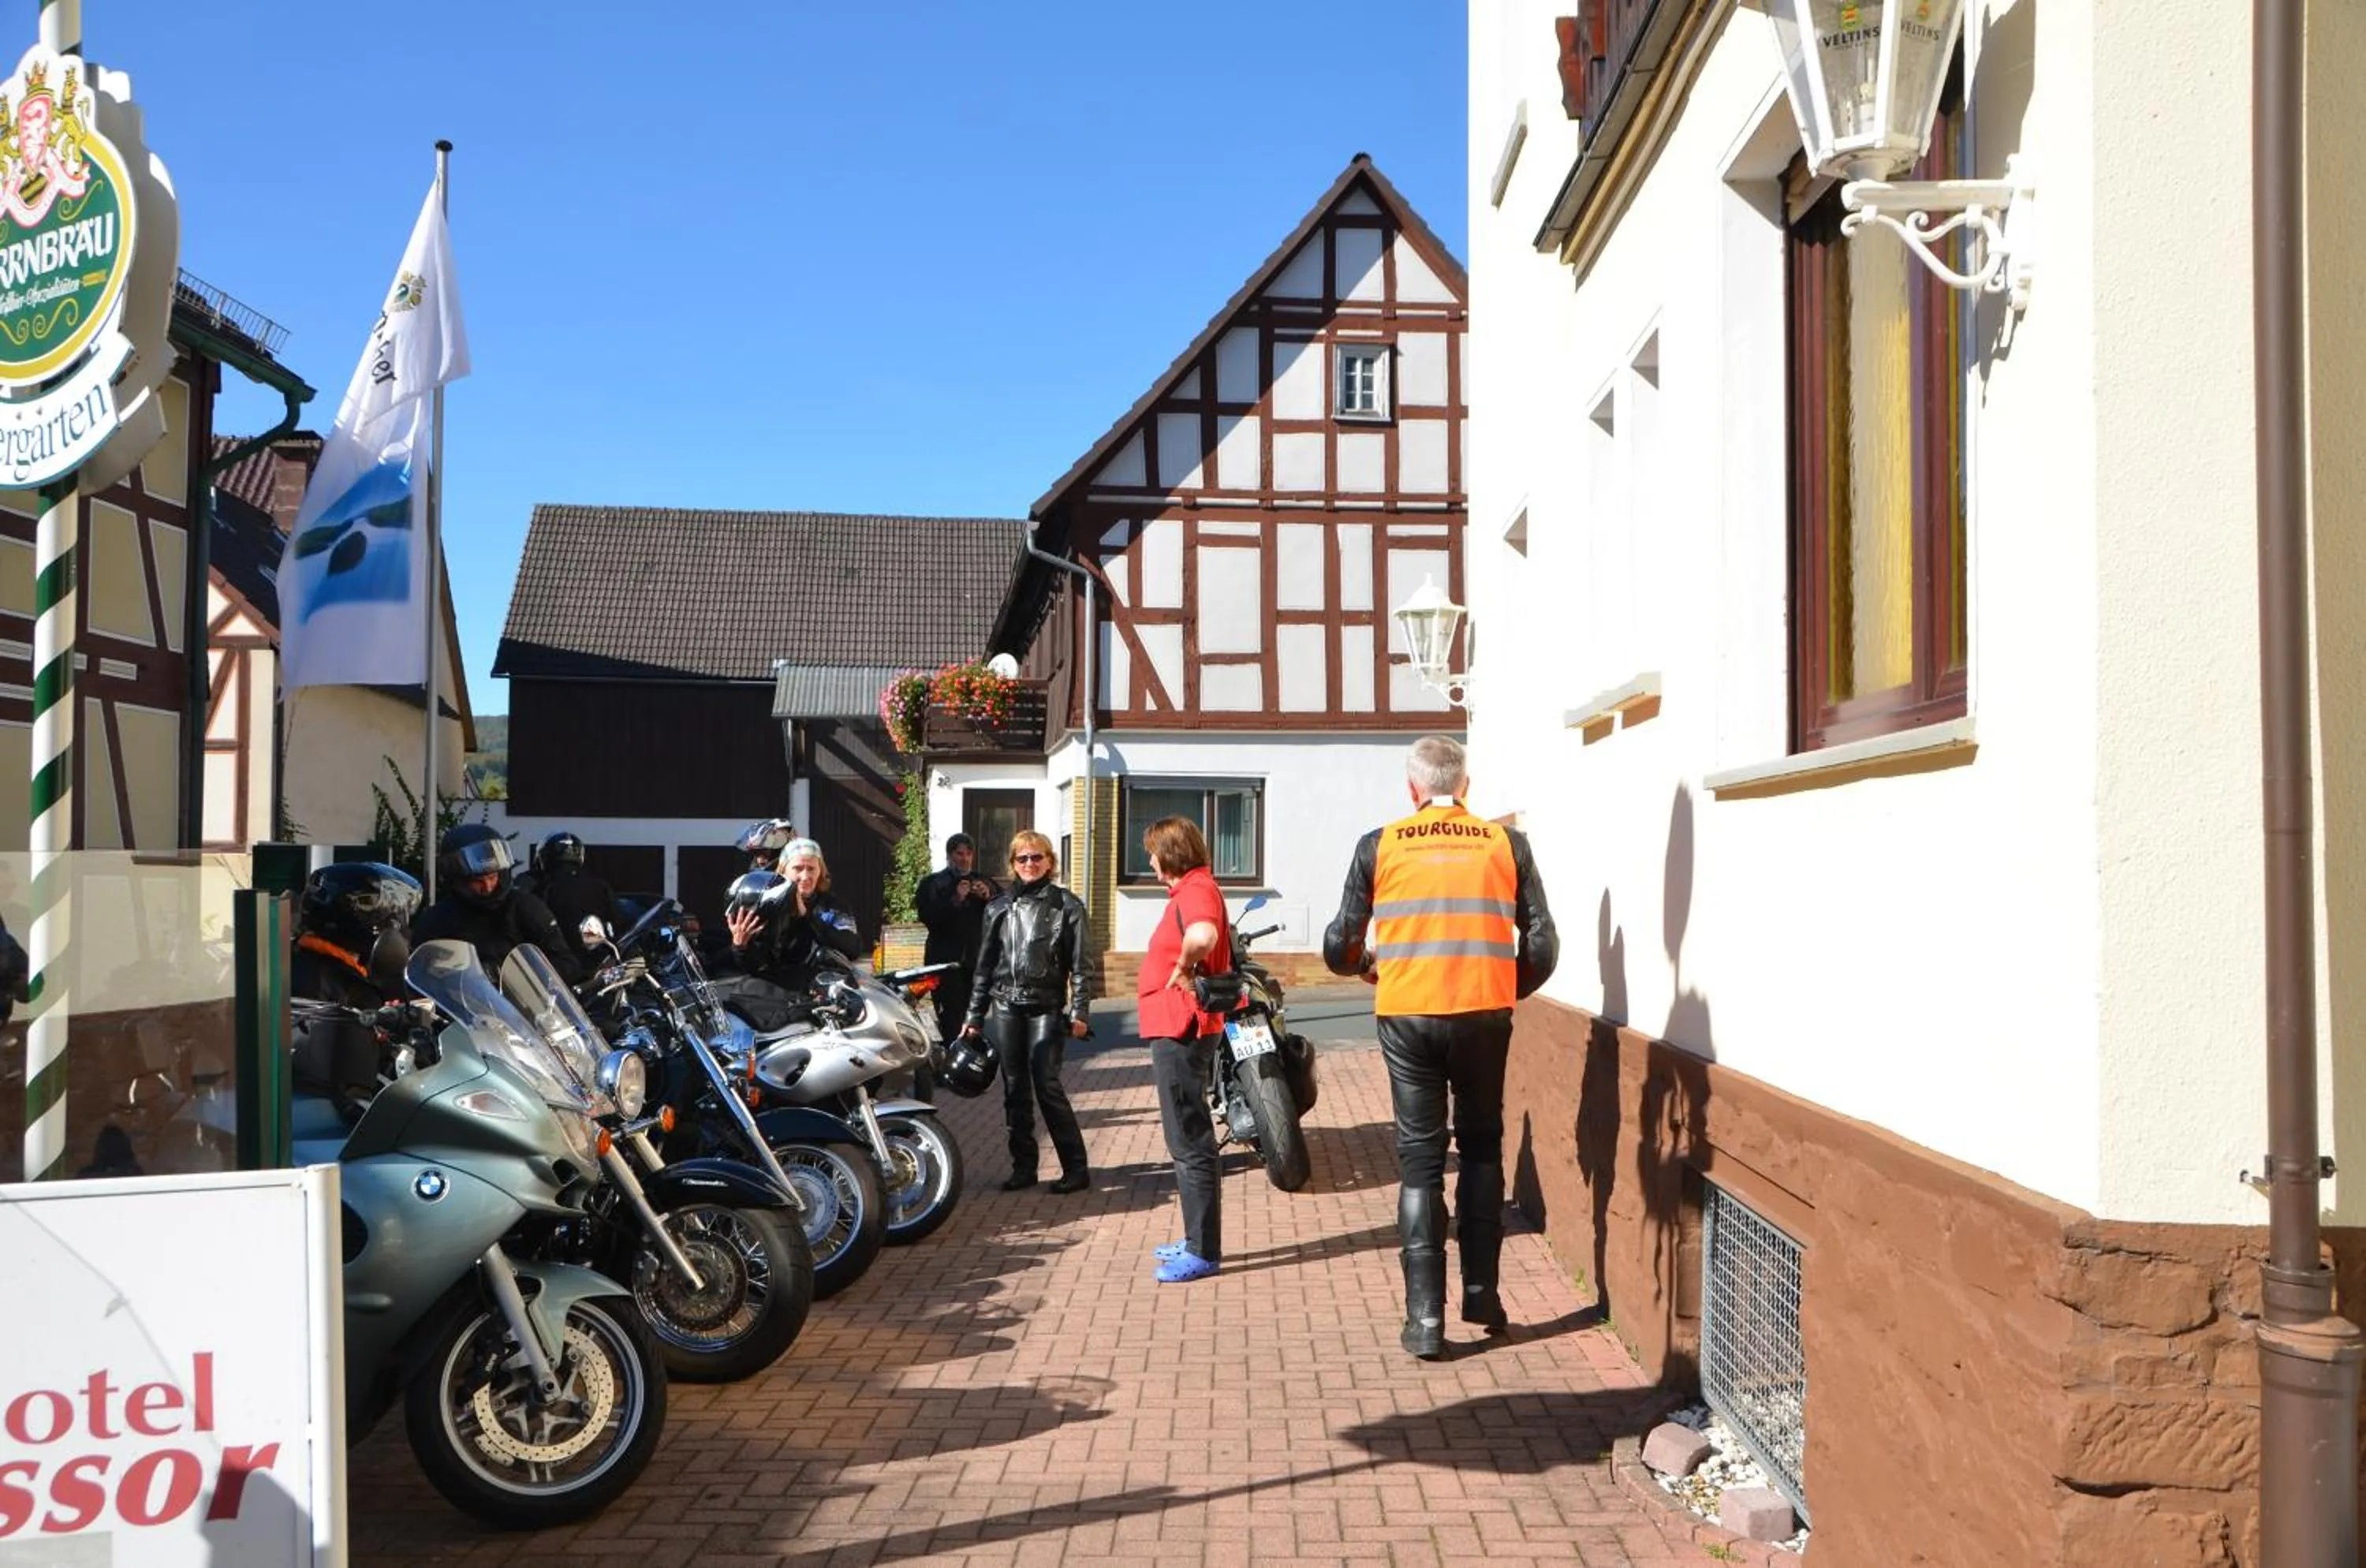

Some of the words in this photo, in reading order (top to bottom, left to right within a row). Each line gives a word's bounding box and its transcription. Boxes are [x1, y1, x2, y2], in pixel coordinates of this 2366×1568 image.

[1823, 25, 1881, 47] VELTINS
[1396, 821, 1491, 840] TOURGUIDE
[5, 1351, 215, 1445] otel
